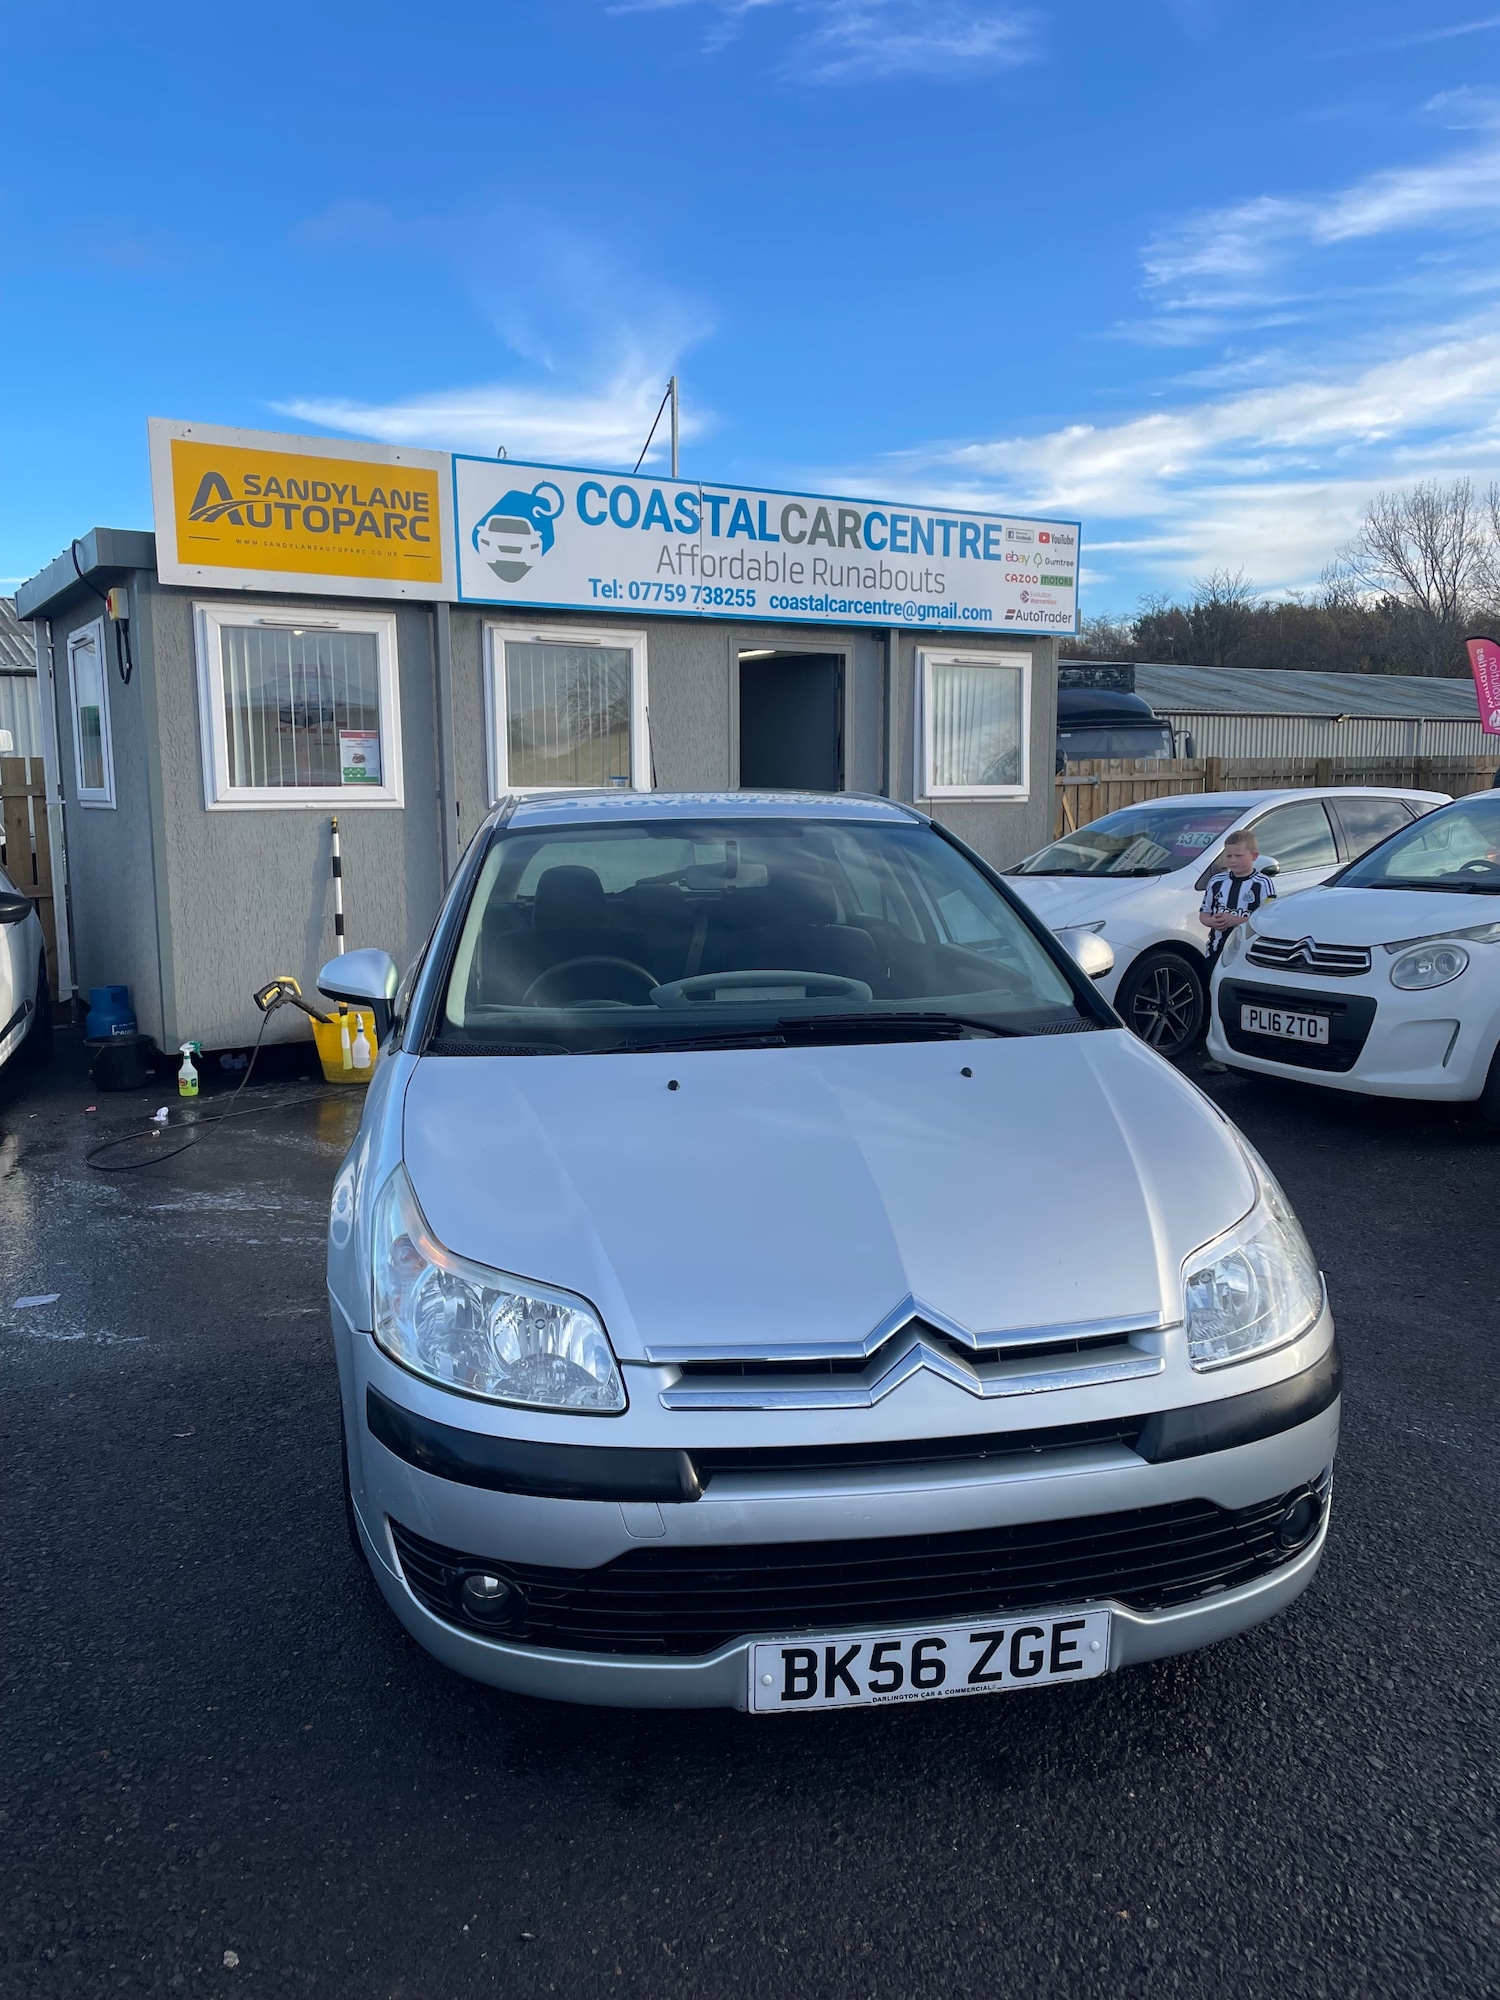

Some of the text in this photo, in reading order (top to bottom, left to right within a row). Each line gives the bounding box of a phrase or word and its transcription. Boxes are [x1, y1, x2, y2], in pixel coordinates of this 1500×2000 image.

[243, 473, 429, 513] SANDYLANE
[1051, 533, 1075, 546] YouTube
[656, 543, 945, 594] Affordable Runabouts
[1044, 557, 1074, 567] Gumtree
[1004, 573, 1039, 584] CAZOO
[588, 577, 993, 621] Tel: 07759 738255 coastalcarcentre@gmail.com
[1015, 609, 1073, 624] AutoTrader
[1250, 1009, 1318, 1038] PL16 ZTO
[781, 1619, 1087, 1702] BK56 ZGE
[872, 1693, 919, 1703] DARLINGTON
